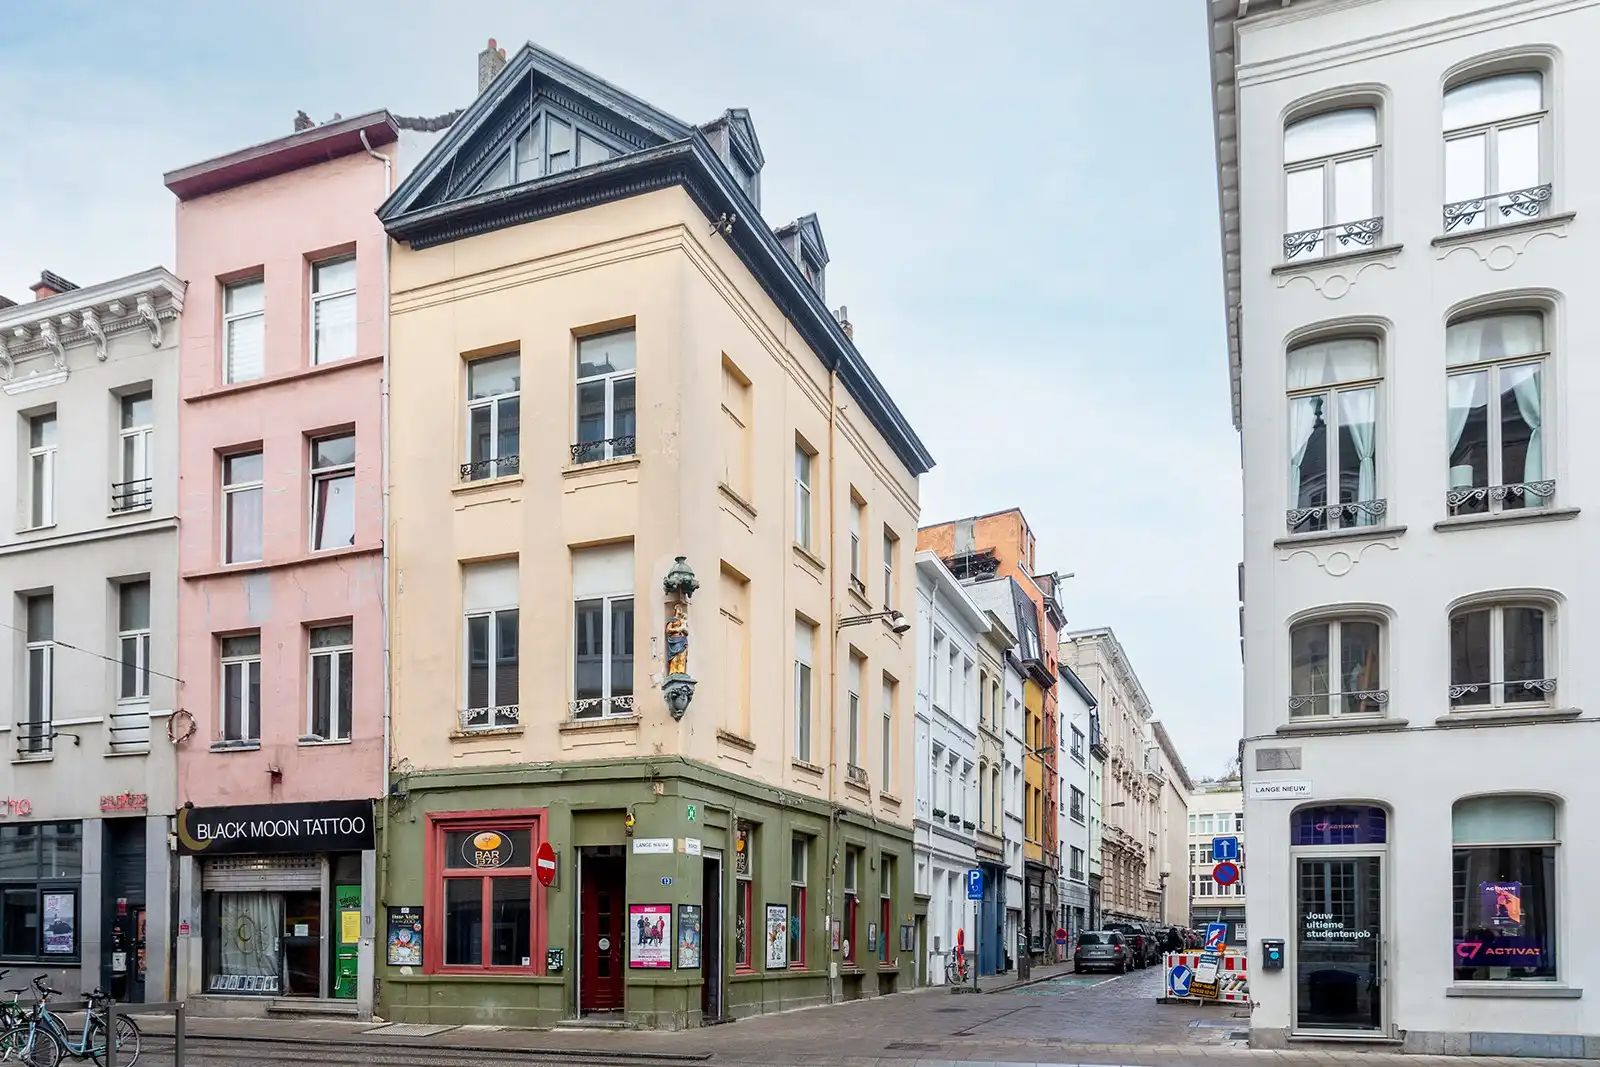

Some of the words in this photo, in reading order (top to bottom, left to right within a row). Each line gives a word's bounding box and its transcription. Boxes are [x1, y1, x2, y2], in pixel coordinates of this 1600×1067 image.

[196, 821, 248, 840] BLACK
[250, 819, 299, 838] MOON
[302, 816, 366, 836] TATTOO
[474, 850, 500, 859] BAR
[474, 858, 500, 866] 1376
[970, 871, 980, 885] P
[1306, 921, 1344, 929] ultieme
[1306, 930, 1371, 939] studentenjob
